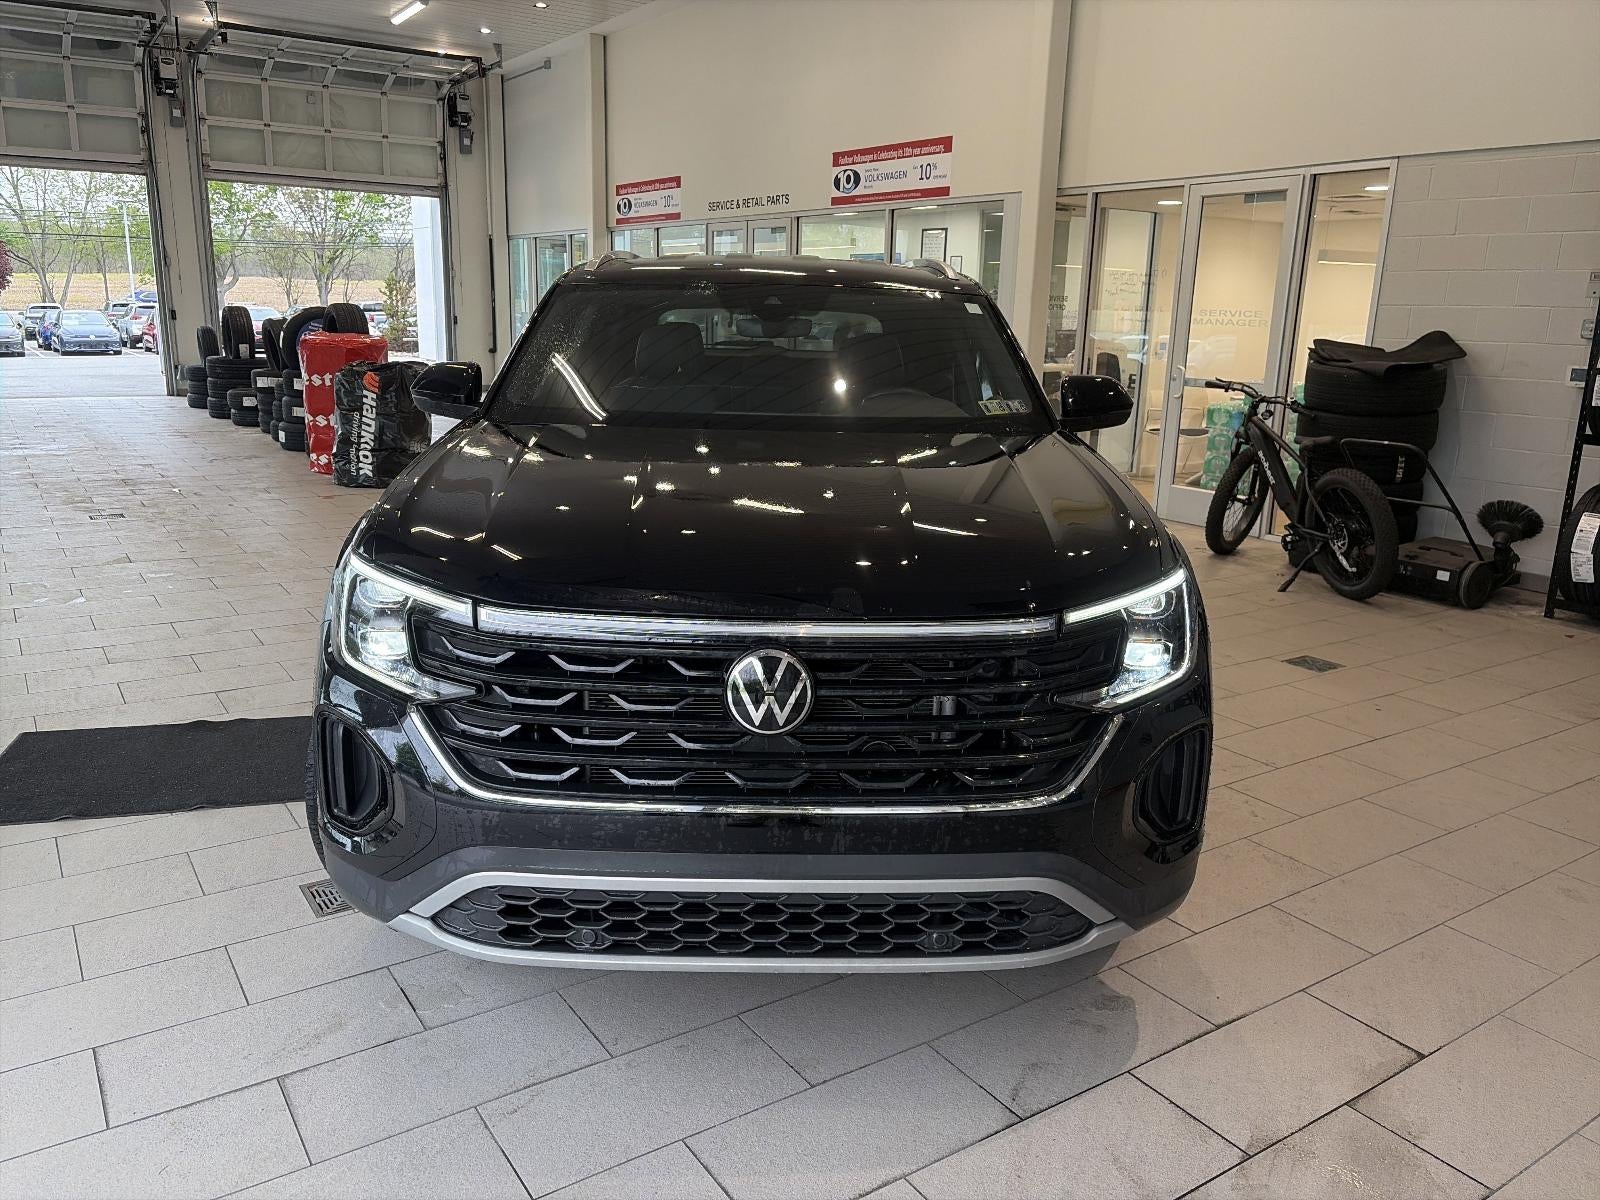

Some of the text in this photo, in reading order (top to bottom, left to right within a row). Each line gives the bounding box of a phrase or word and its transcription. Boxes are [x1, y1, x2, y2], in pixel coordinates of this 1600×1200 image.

[853, 153, 873, 164] Volkswagen
[864, 170, 907, 183] VOLKSWAGEN
[708, 193, 790, 211] SERVICE & RETAIL PARTS
[1199, 309, 1265, 319] SERVICE
[1192, 318, 1270, 328] MANAGER
